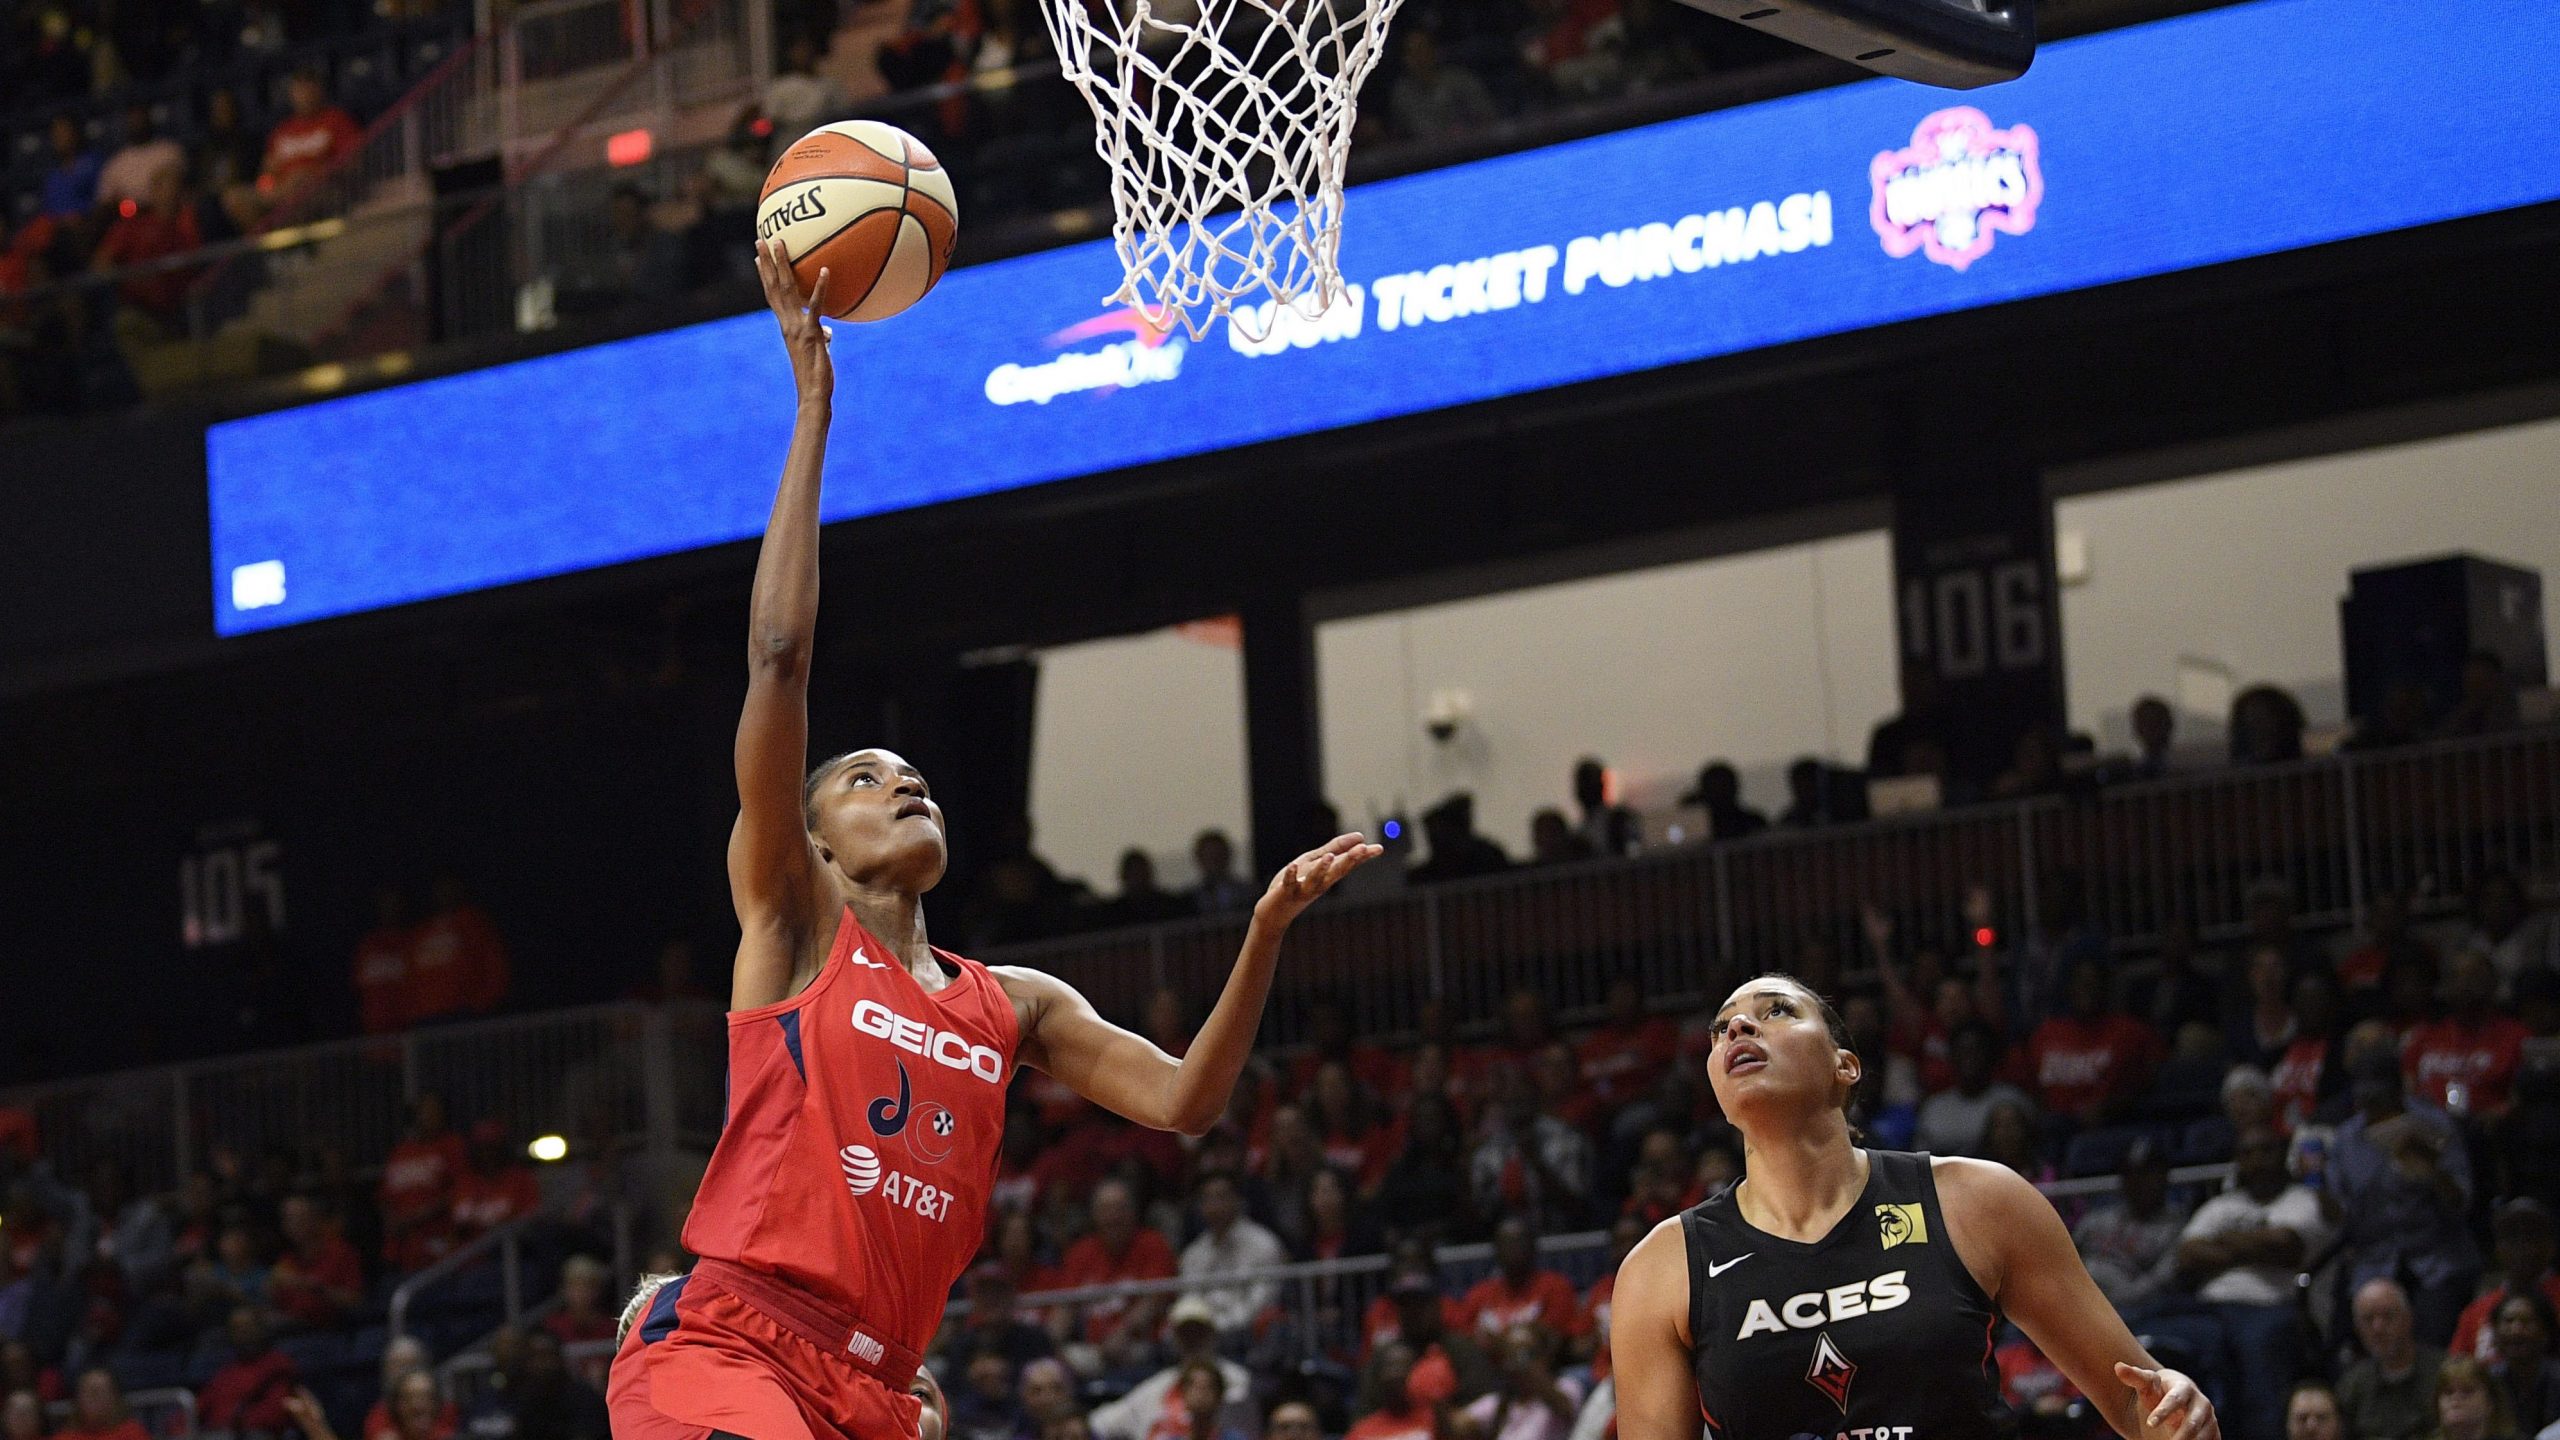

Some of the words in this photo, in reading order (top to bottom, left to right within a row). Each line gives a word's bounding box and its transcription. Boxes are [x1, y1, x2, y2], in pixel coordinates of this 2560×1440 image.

[1372, 245, 1559, 331] TICKET
[1904, 558, 2045, 678] 106
[181, 841, 287, 946] 105
[851, 999, 1003, 1084] GEICO
[882, 1170, 954, 1224] AT&T
[1736, 1270, 1911, 1341] ACES
